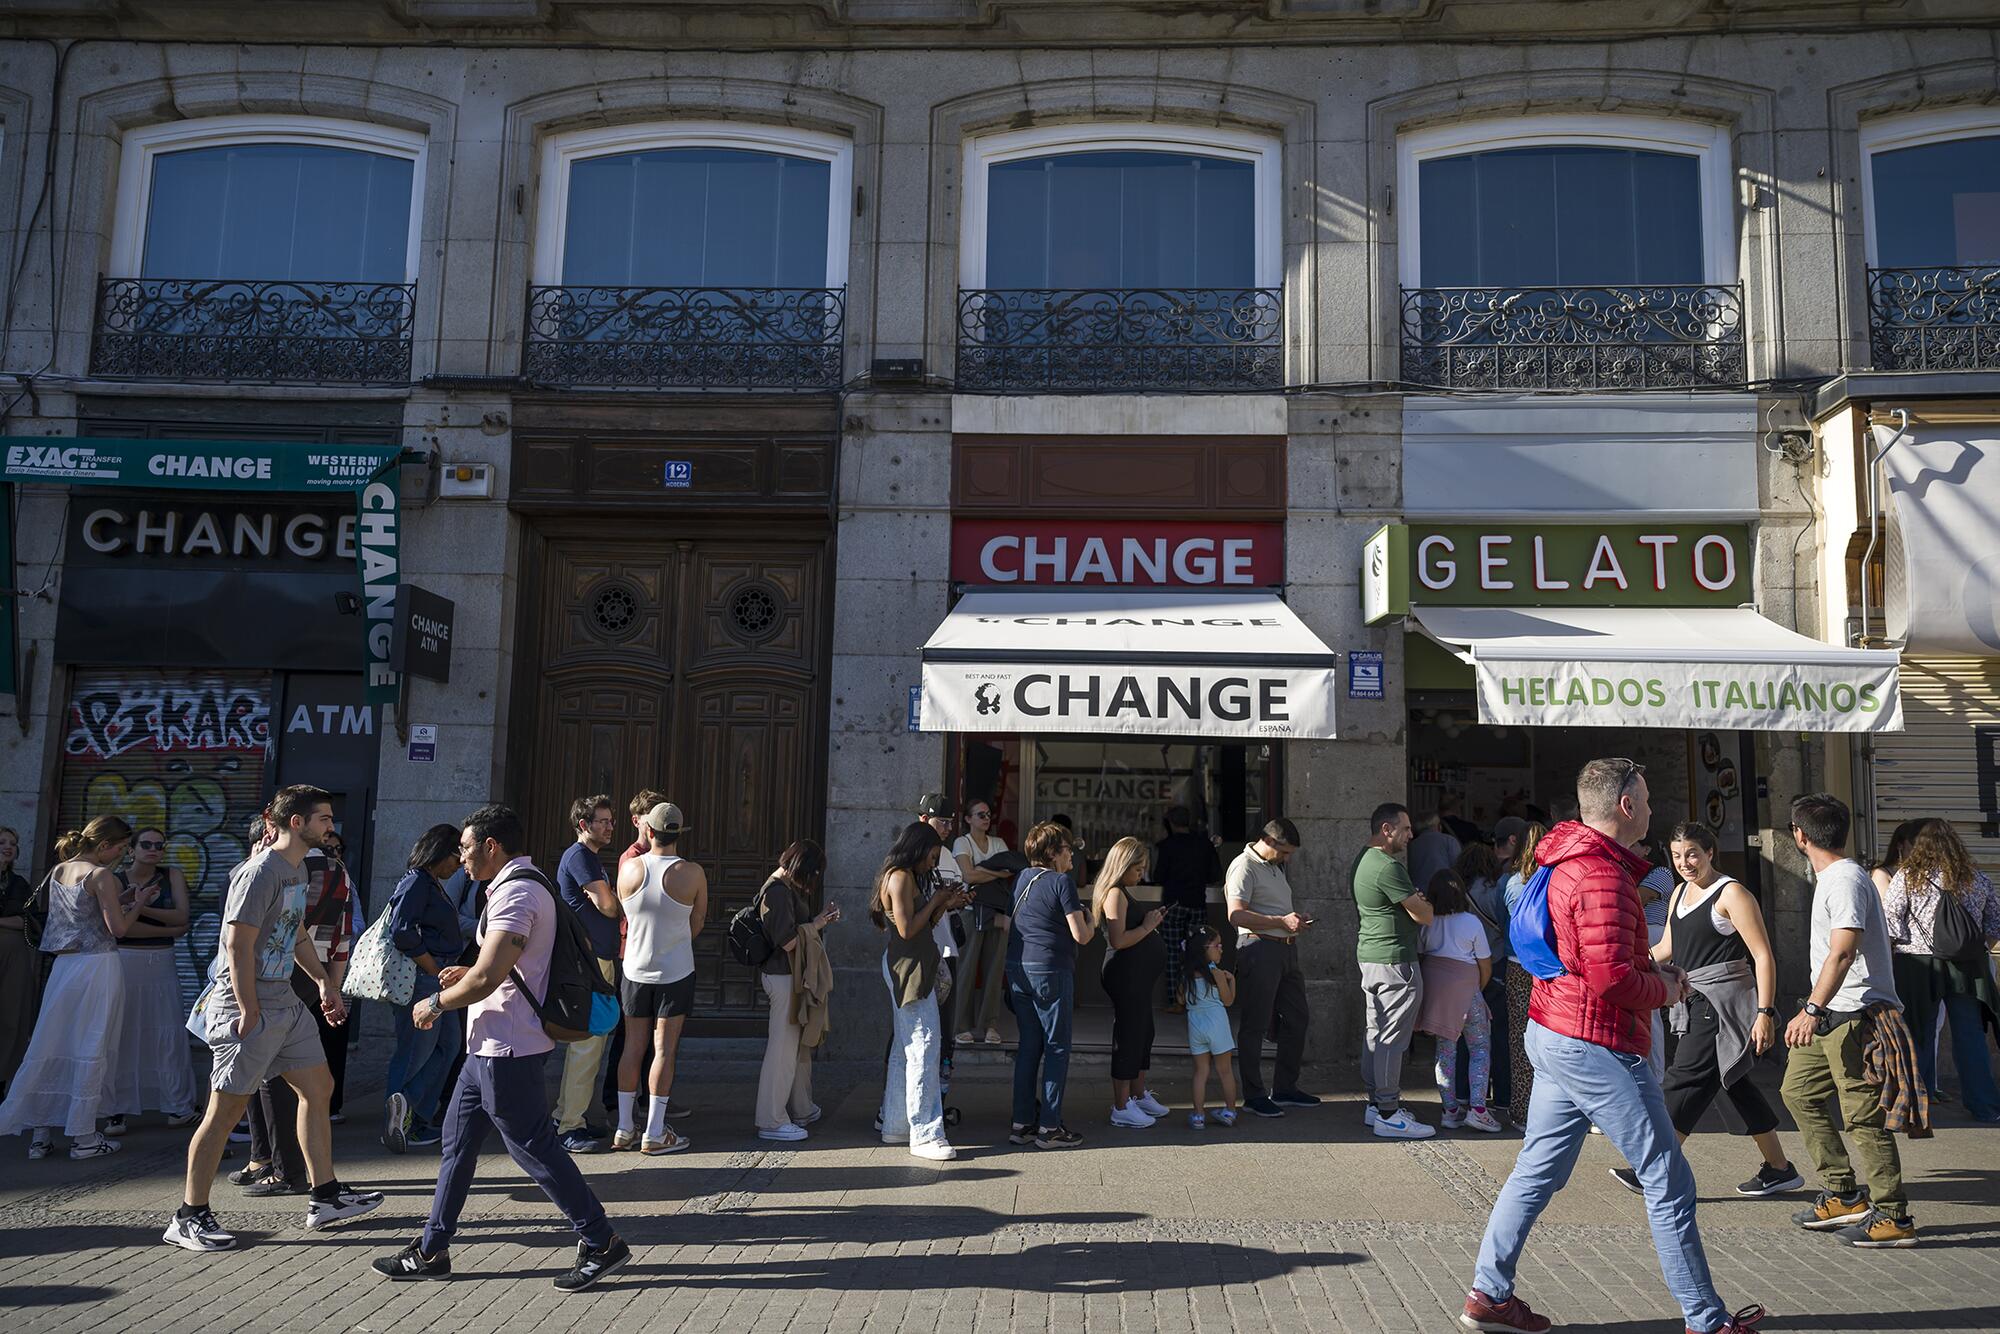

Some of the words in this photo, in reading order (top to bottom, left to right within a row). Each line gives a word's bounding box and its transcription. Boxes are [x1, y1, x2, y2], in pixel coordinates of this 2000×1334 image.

[81, 455, 122, 464] TRANSFER
[148, 454, 271, 479] CHANGE
[307, 455, 378, 466] WESTERN
[668, 464, 687, 478] 12
[306, 478, 331, 486] moving
[980, 536, 1254, 584] CHANGE
[1417, 534, 1736, 591] GELATO
[361, 482, 397, 687] CHANGE
[411, 614, 449, 641] CHANGE
[1013, 617, 1282, 627] CHANGE
[420, 636, 438, 653] ATM
[1013, 674, 1290, 722] CHANGE
[1501, 677, 1666, 707] HELADOS
[1692, 680, 1881, 713] ITALIANOS
[287, 704, 372, 735] ATM
[1259, 723, 1292, 732] ESPAÑA
[1053, 778, 1172, 800] CHANGE
